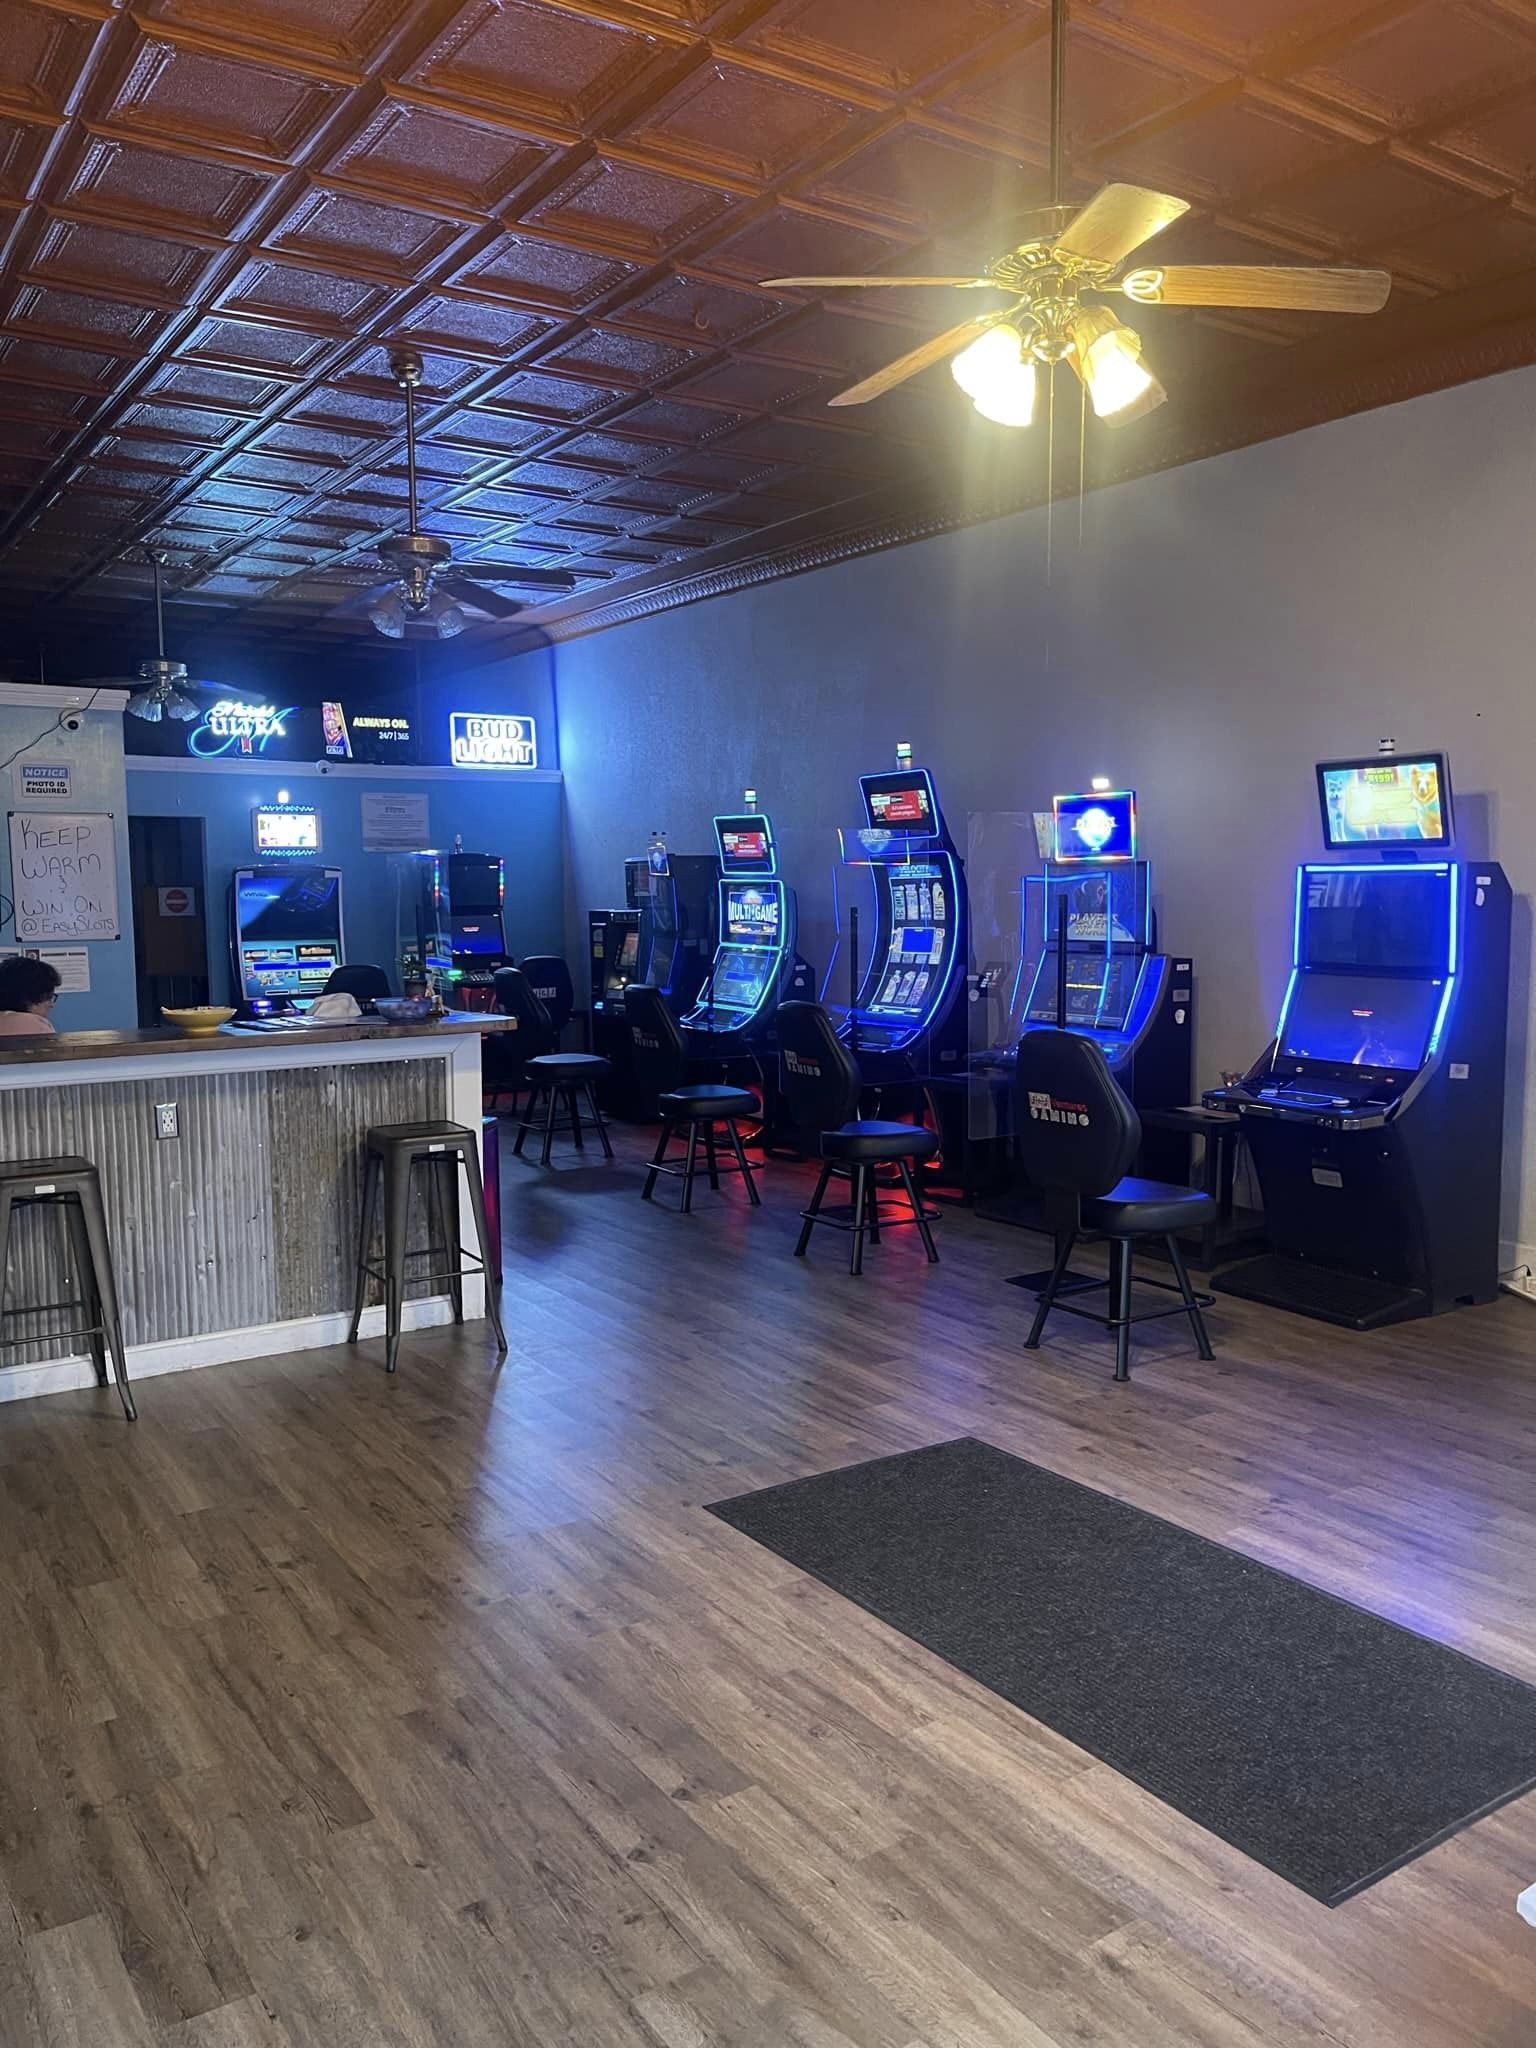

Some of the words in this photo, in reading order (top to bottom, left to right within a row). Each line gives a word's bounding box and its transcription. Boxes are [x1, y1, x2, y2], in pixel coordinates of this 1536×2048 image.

[209, 716, 286, 735] ULTRA
[352, 717, 390, 728] ALWAYS
[467, 719, 523, 740] BUD
[456, 738, 532, 763] LIGHT
[25, 768, 66, 777] NOTICE
[21, 819, 91, 854] KEEP
[21, 853, 101, 880] WARM
[22, 900, 64, 917] WIN
[74, 895, 102, 914] ON
[1069, 912, 1119, 923] PLAYES
